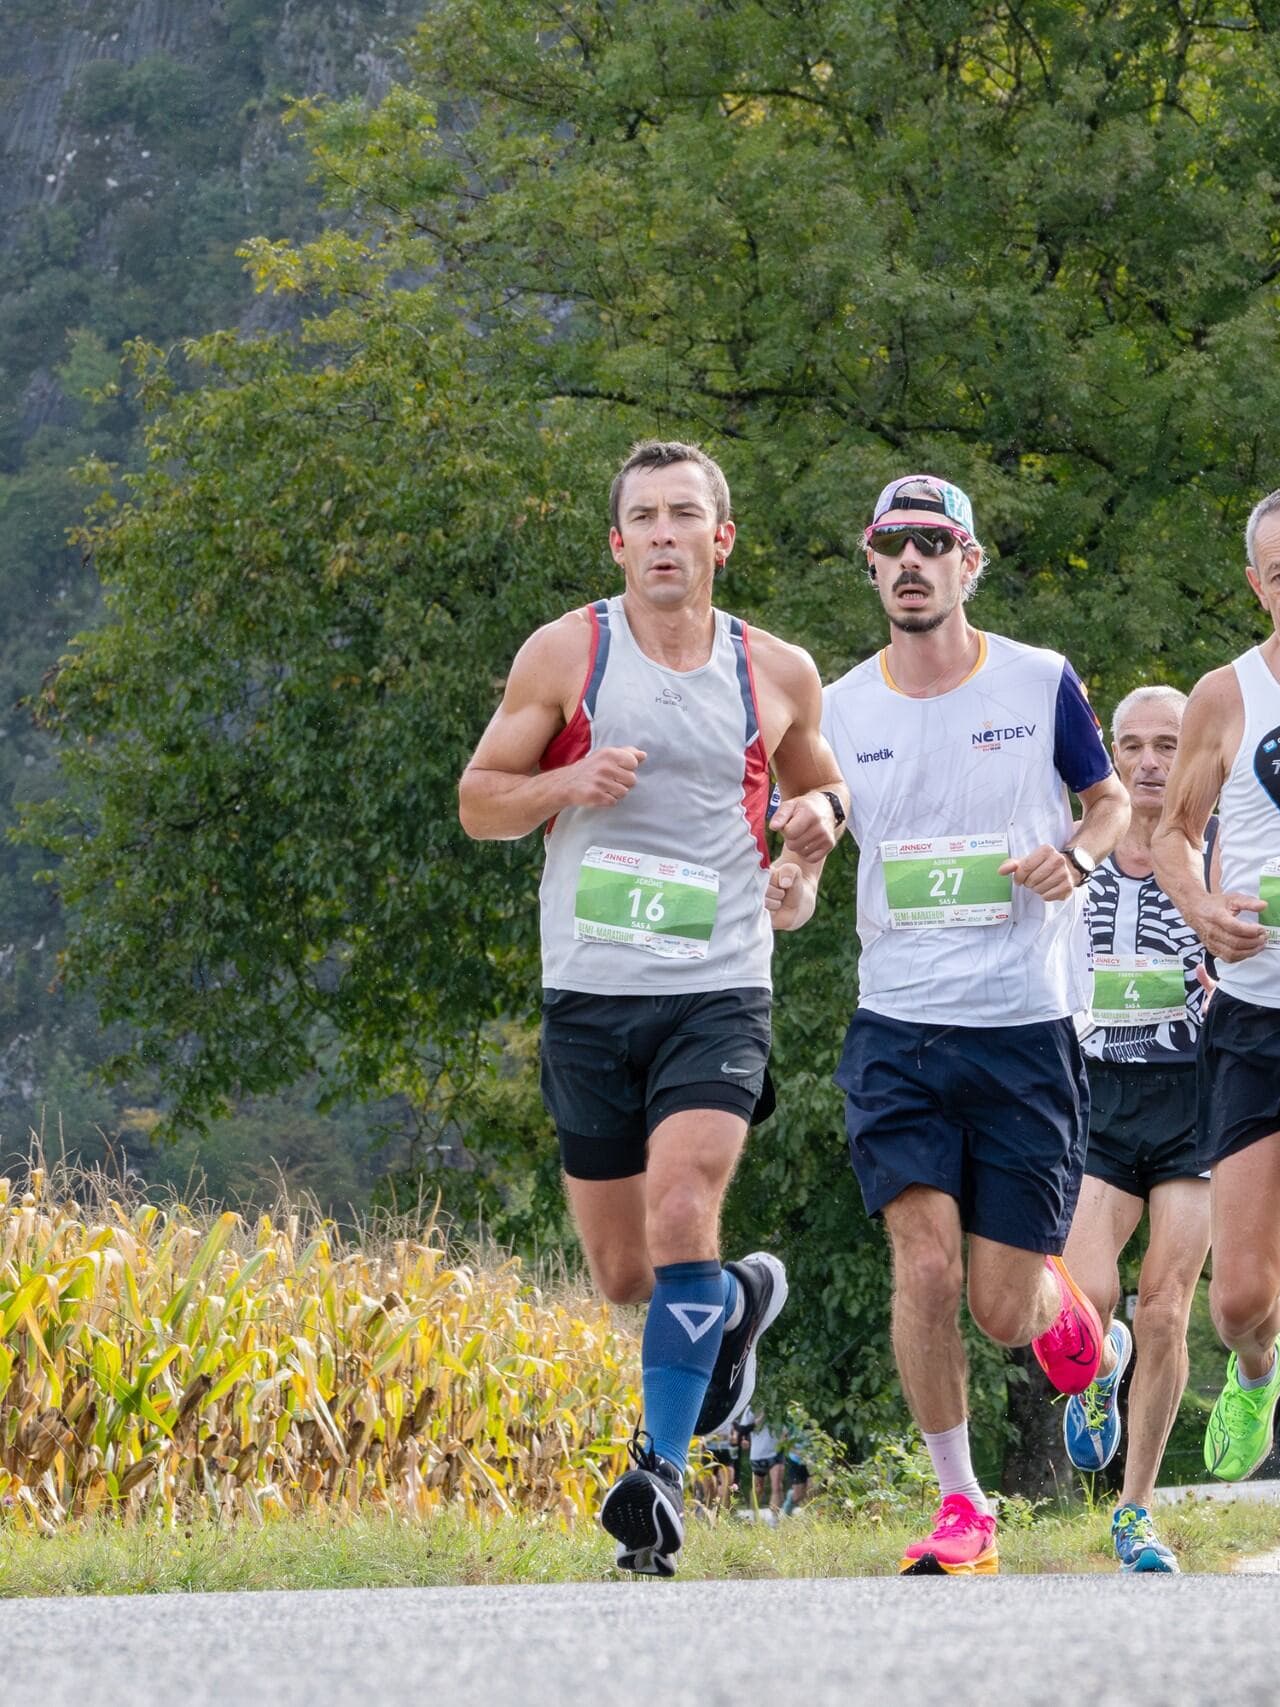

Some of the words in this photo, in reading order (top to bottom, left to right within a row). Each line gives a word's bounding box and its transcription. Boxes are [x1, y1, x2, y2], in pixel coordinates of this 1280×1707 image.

[856, 748, 894, 764] kinetik
[899, 842, 932, 850] ANNECY
[603, 851, 641, 865] ANNECY
[928, 867, 964, 897] 27
[628, 887, 665, 922] 16
[631, 921, 645, 929] SAS
[1124, 979, 1140, 1001] 4
